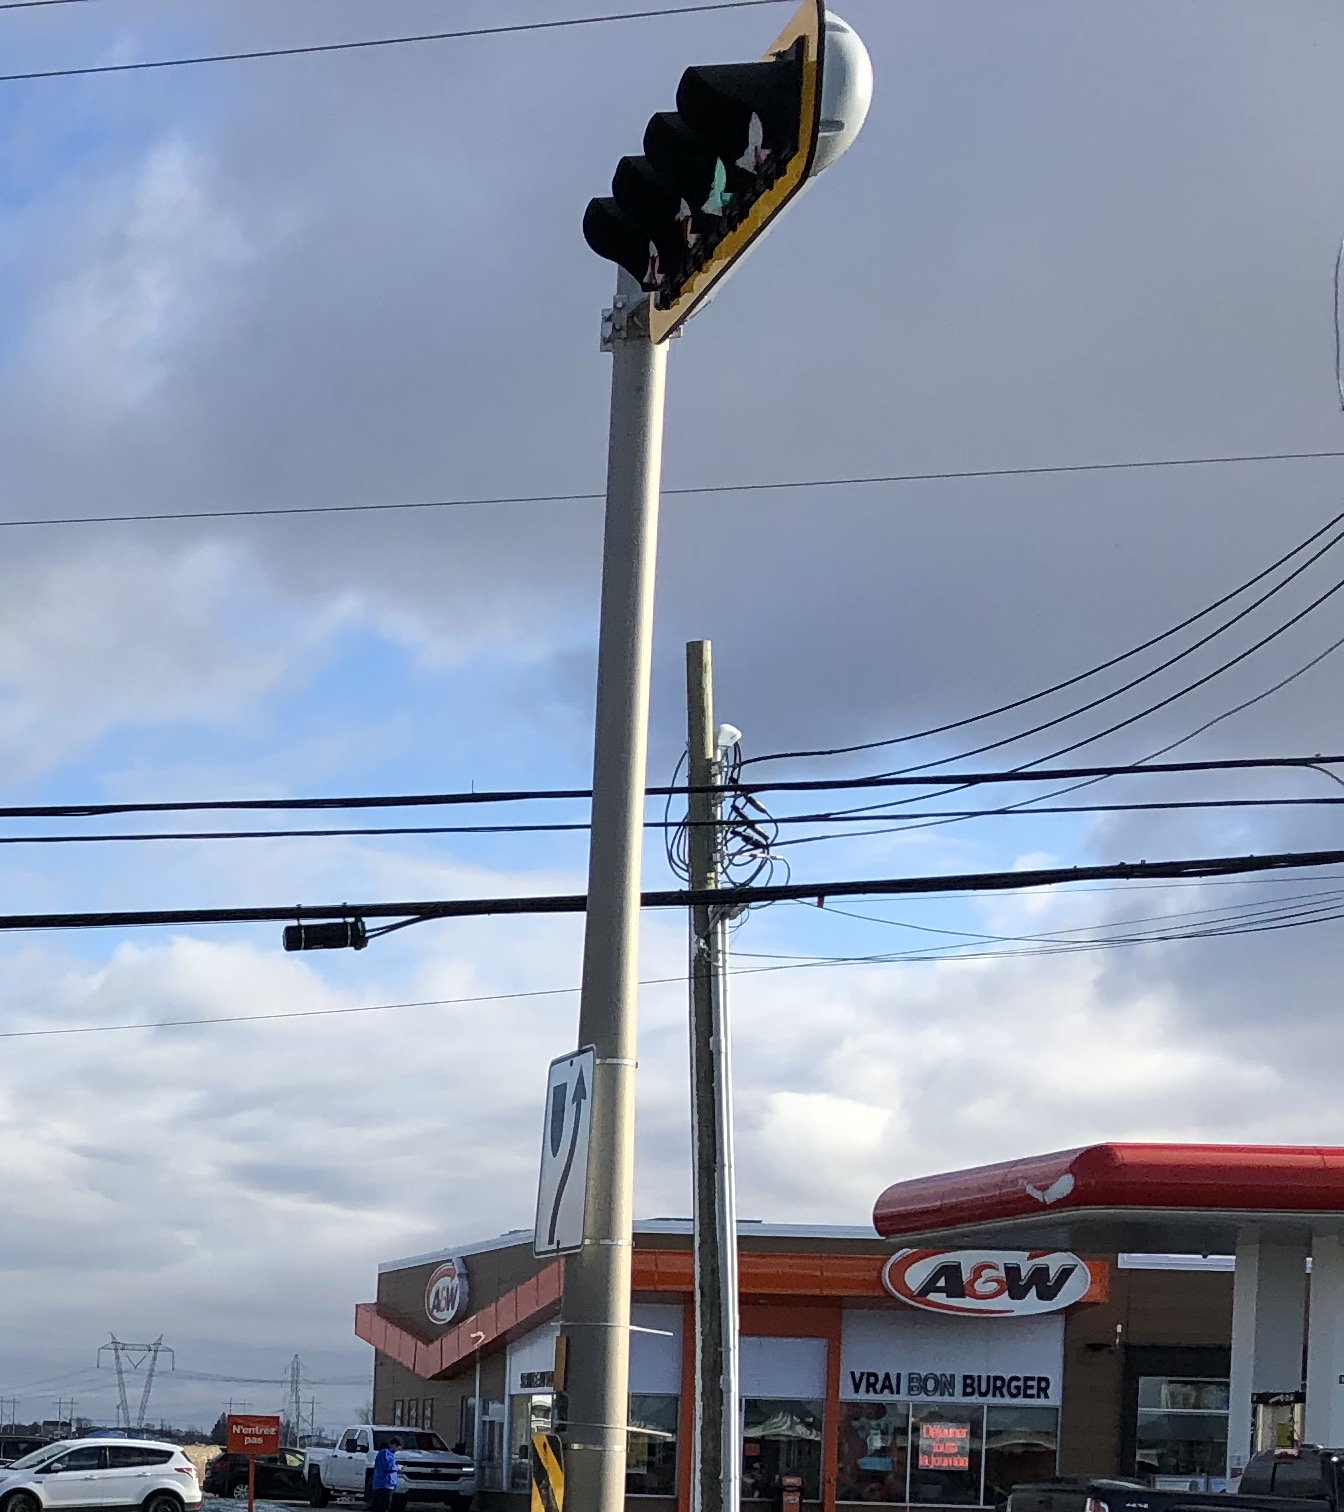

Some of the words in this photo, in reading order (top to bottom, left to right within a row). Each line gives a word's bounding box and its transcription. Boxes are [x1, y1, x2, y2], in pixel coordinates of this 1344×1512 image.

[912, 1260, 1078, 1302] A&W
[849, 1371, 902, 1395] VRAI
[907, 1372, 956, 1397] BON
[962, 1374, 1051, 1399] BURGER
